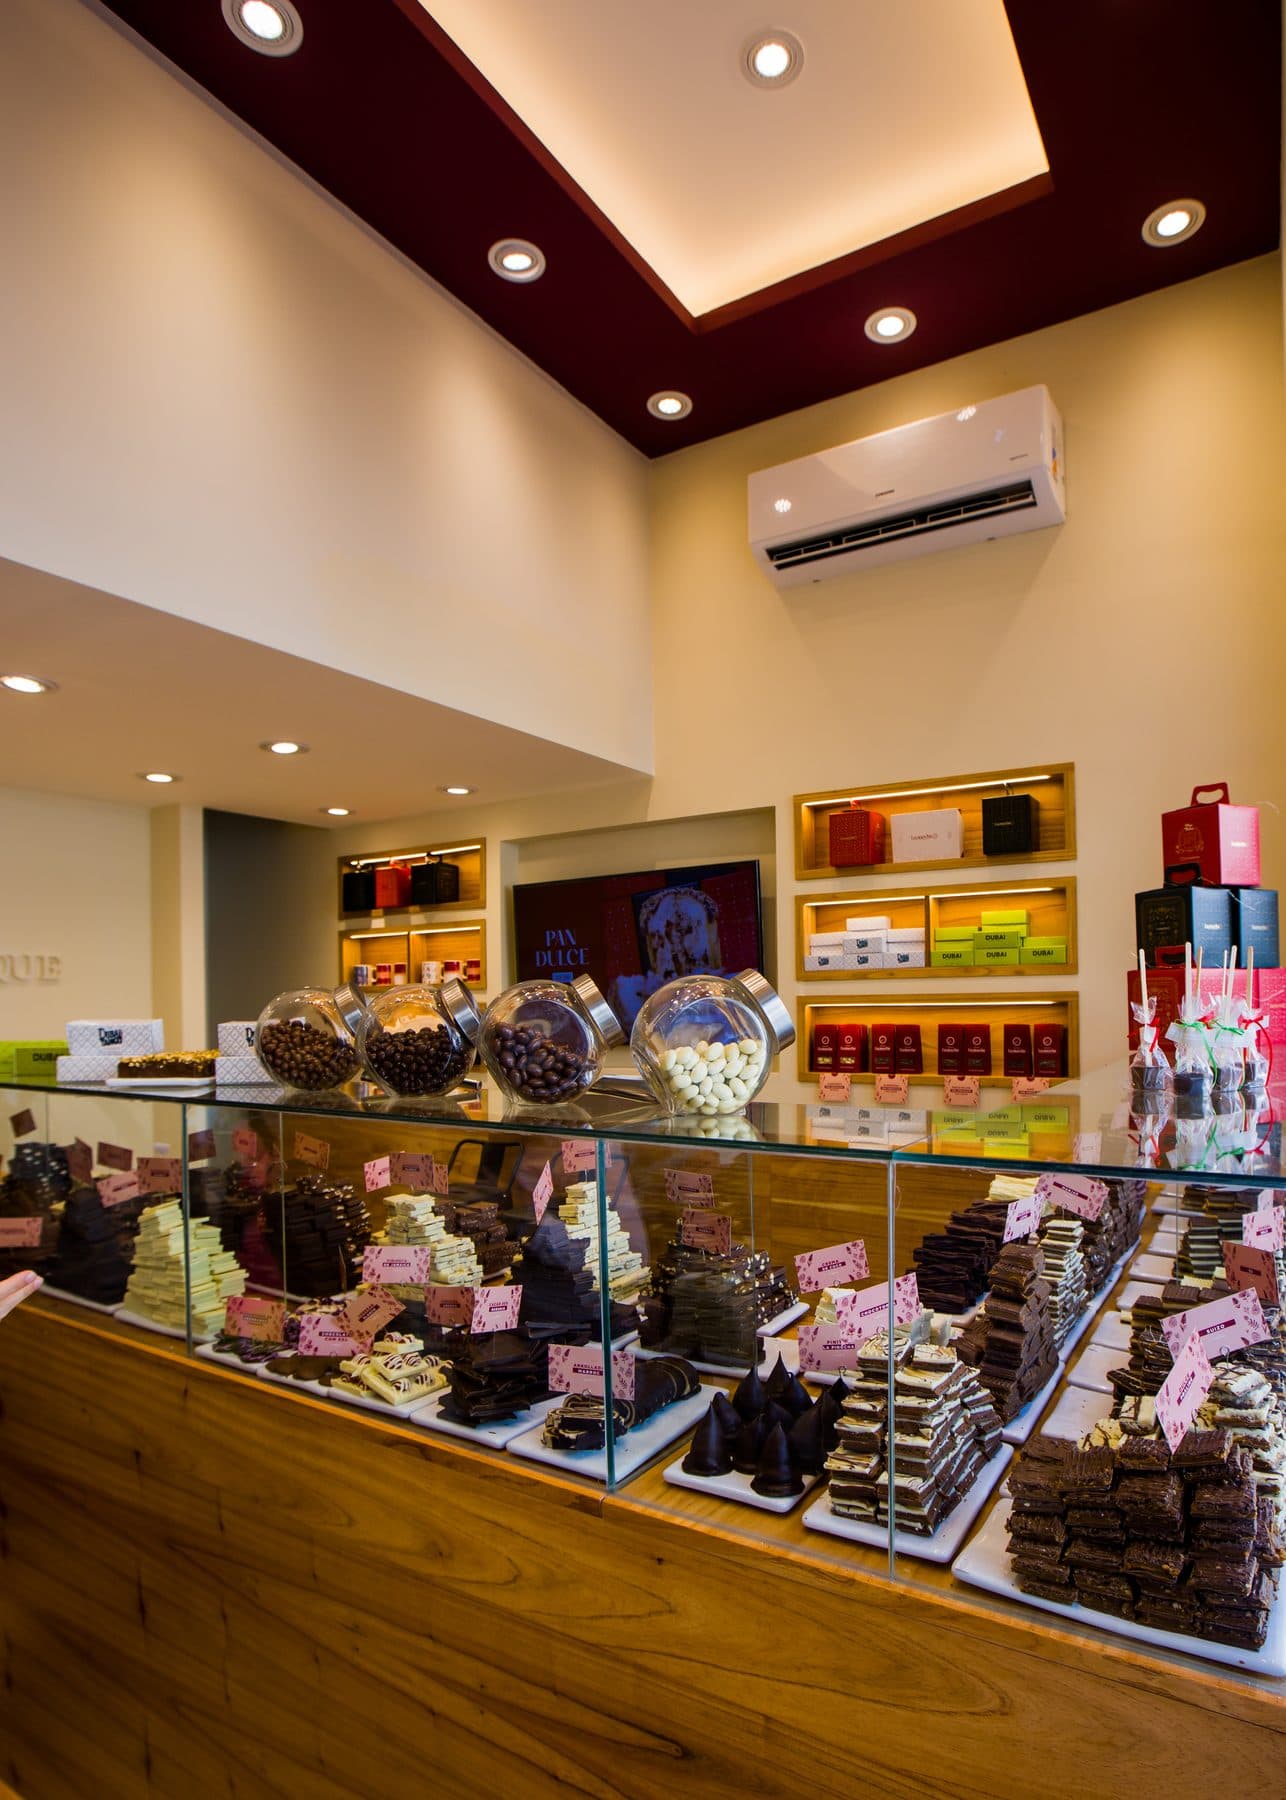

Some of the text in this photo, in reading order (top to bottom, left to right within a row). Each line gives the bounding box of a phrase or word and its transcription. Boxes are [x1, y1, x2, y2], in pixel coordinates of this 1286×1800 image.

[545, 928, 577, 947] PAN
[535, 947, 590, 967] DULCE
[1206, 1324, 1225, 1334] SUIZO
